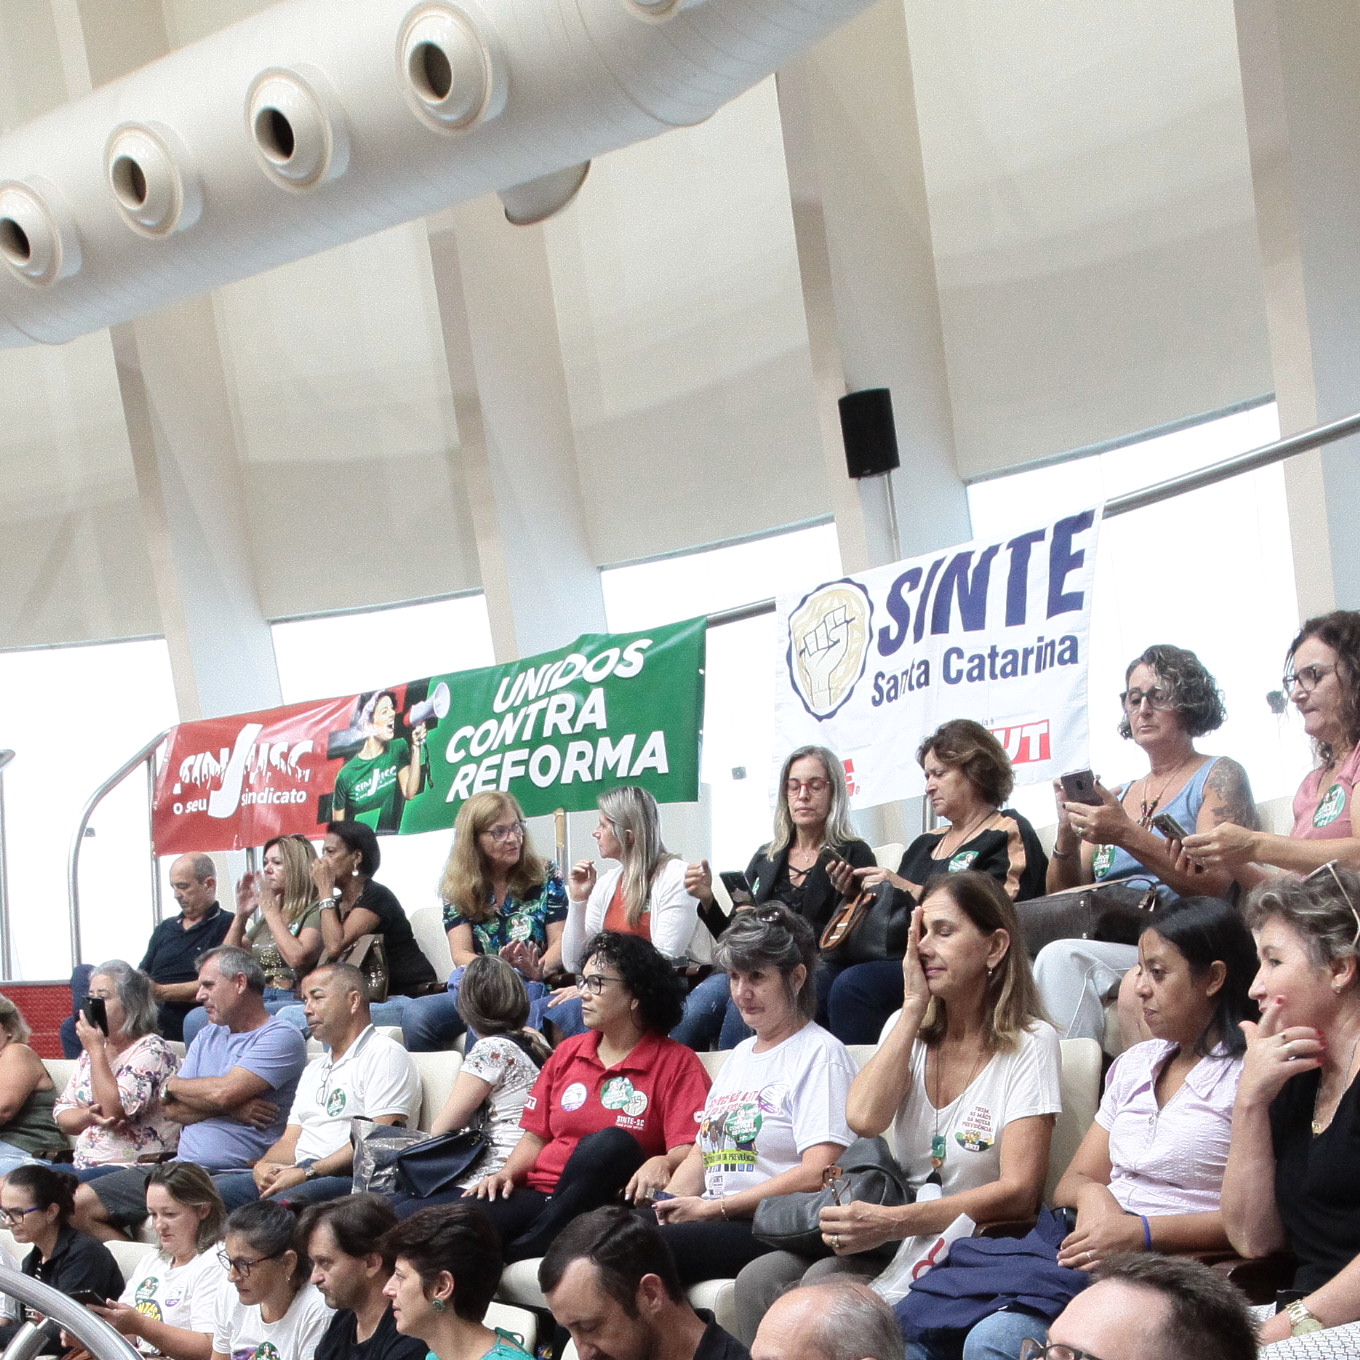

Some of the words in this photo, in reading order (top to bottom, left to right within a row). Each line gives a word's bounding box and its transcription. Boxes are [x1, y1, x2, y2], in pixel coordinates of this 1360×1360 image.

[877, 509, 1095, 657] SINTE
[493, 638, 653, 713] UNIDOS
[871, 657, 931, 707] Santa
[942, 634, 1079, 685] Catarina
[446, 687, 607, 763] CONTRA
[173, 803, 183, 814] o
[185, 798, 207, 814] seu
[241, 787, 307, 806] sindicato
[446, 730, 669, 803] REFORMA
